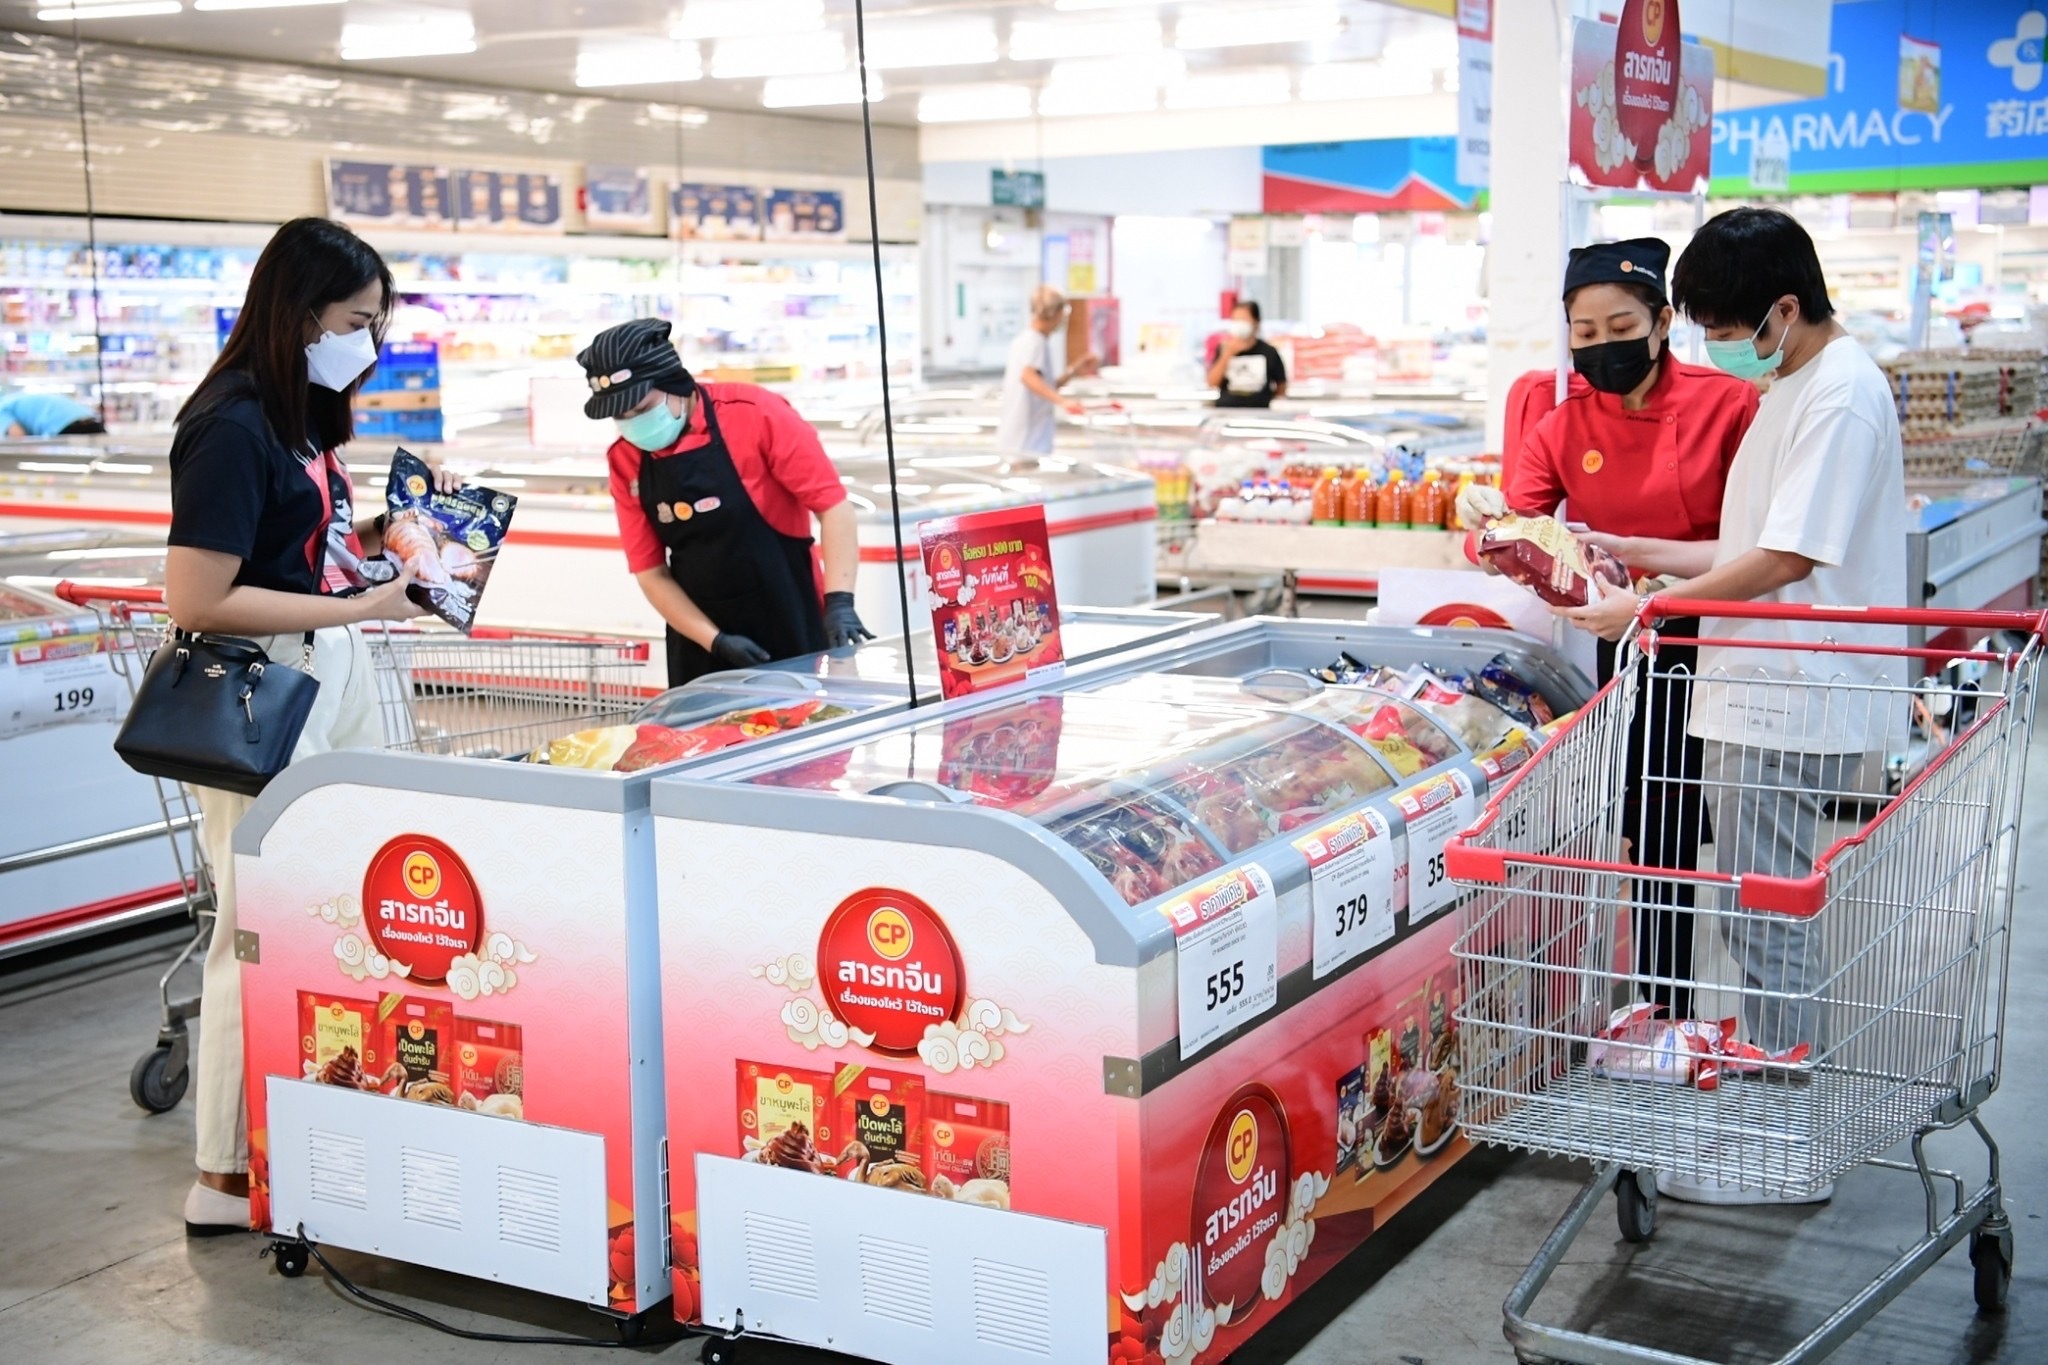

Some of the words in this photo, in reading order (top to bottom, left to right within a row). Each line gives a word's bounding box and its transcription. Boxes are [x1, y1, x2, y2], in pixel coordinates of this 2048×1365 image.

[1646, 1, 1661, 26] CP
[1623, 47, 1671, 86] สารทจีน
[1711, 103, 1954, 154] PHARMACY
[408, 480, 424, 491] CP
[962, 543, 986, 560] ซื้อครบ
[988, 541, 1008, 557] 1,800
[1008, 540, 1023, 553] บาท
[981, 562, 1009, 586] รับทันที
[1024, 575, 1038, 588] 100
[54, 687, 94, 712] 199
[1330, 822, 1364, 854] ราคาพิเศษ
[409, 865, 434, 885] CP
[1427, 852, 1444, 888] 35
[1201, 880, 1242, 920] ราคาพิเศษ
[380, 899, 465, 929] สารทจีน
[1336, 893, 1367, 937] 379
[381, 923, 433, 944] เรื่องของไหว้
[436, 935, 468, 949] ไว้ใจเรา
[874, 922, 905, 944] CP
[838, 960, 942, 995] สารทจีน
[1207, 960, 1244, 1011] 555
[332, 1007, 343, 1016] CP
[840, 987, 903, 1011] เรื่องของไหว้
[905, 1000, 945, 1017] ไว้ใจเรา
[410, 1024, 422, 1033] CP
[398, 1038, 435, 1056] เป็ดพะโล้
[462, 1049, 475, 1059] CP
[402, 1053, 431, 1066] ต้นตำรับ
[778, 1079, 791, 1089] CP
[760, 1097, 810, 1113] ขาหมูพะโล้
[873, 1100, 887, 1110] CP
[858, 1114, 903, 1135] เป็ดพะโล้
[936, 1129, 951, 1140] CP
[863, 1131, 897, 1145] ต้นตำรับ
[1231, 1128, 1252, 1166] CP
[1205, 1165, 1276, 1246] สารทจีน
[1207, 1229, 1251, 1276] เรื่องของไหว้
[1252, 1211, 1278, 1240] ไว้ใจเรา
